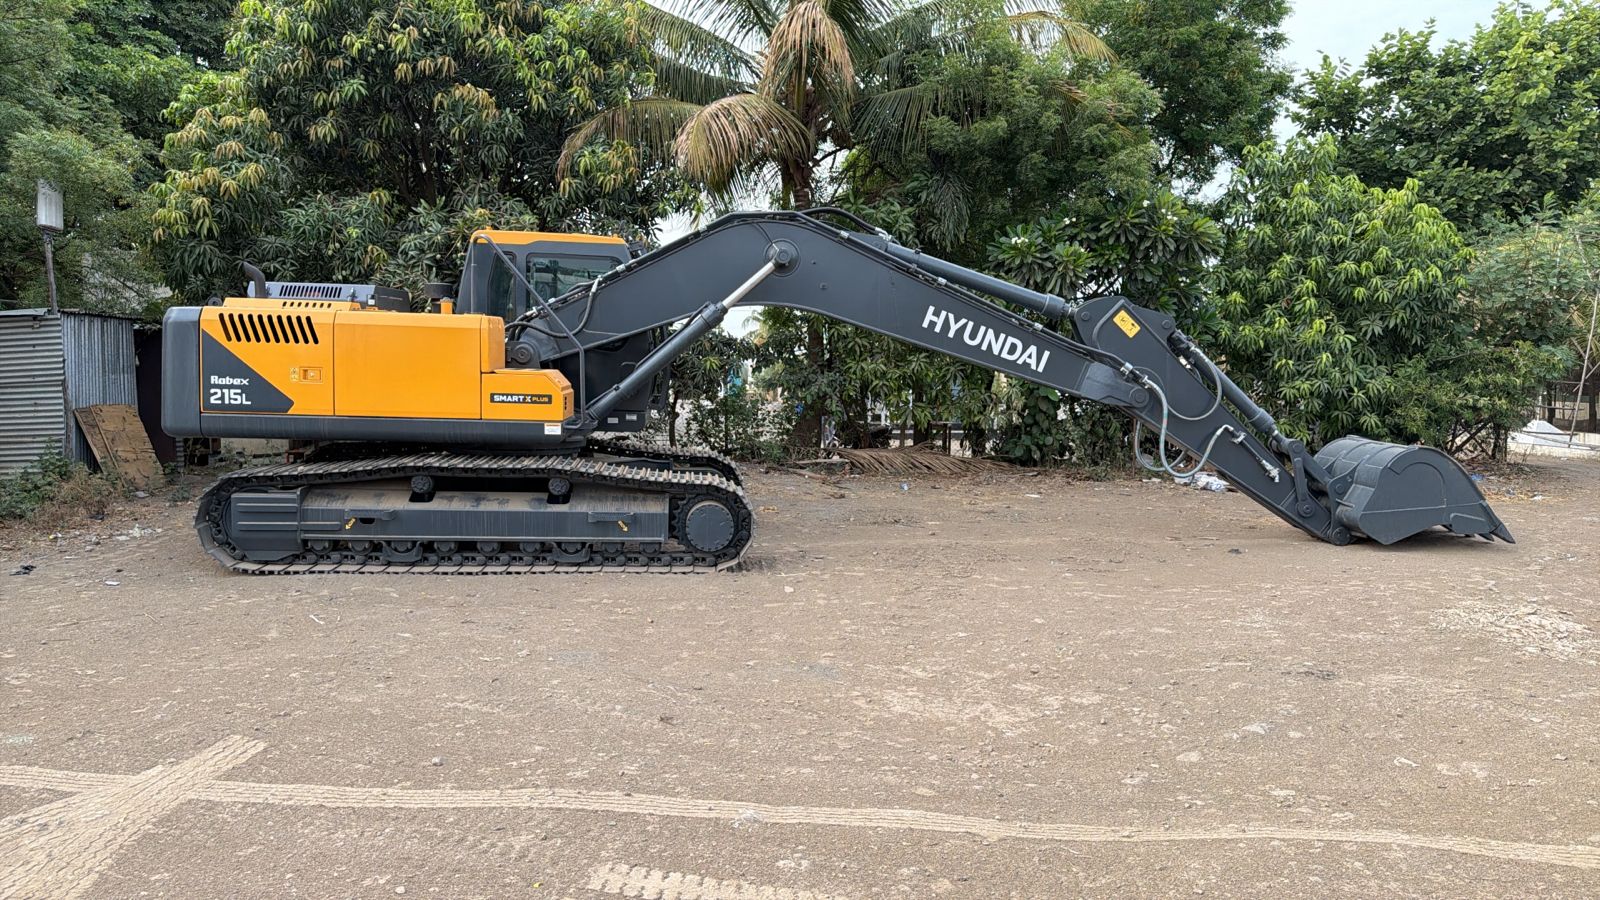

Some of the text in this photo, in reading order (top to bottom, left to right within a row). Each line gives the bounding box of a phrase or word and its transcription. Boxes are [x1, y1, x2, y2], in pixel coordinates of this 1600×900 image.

[921, 305, 1051, 373] HYUNDAI
[210, 388, 252, 405] 215L
[493, 394, 525, 402] SMART
